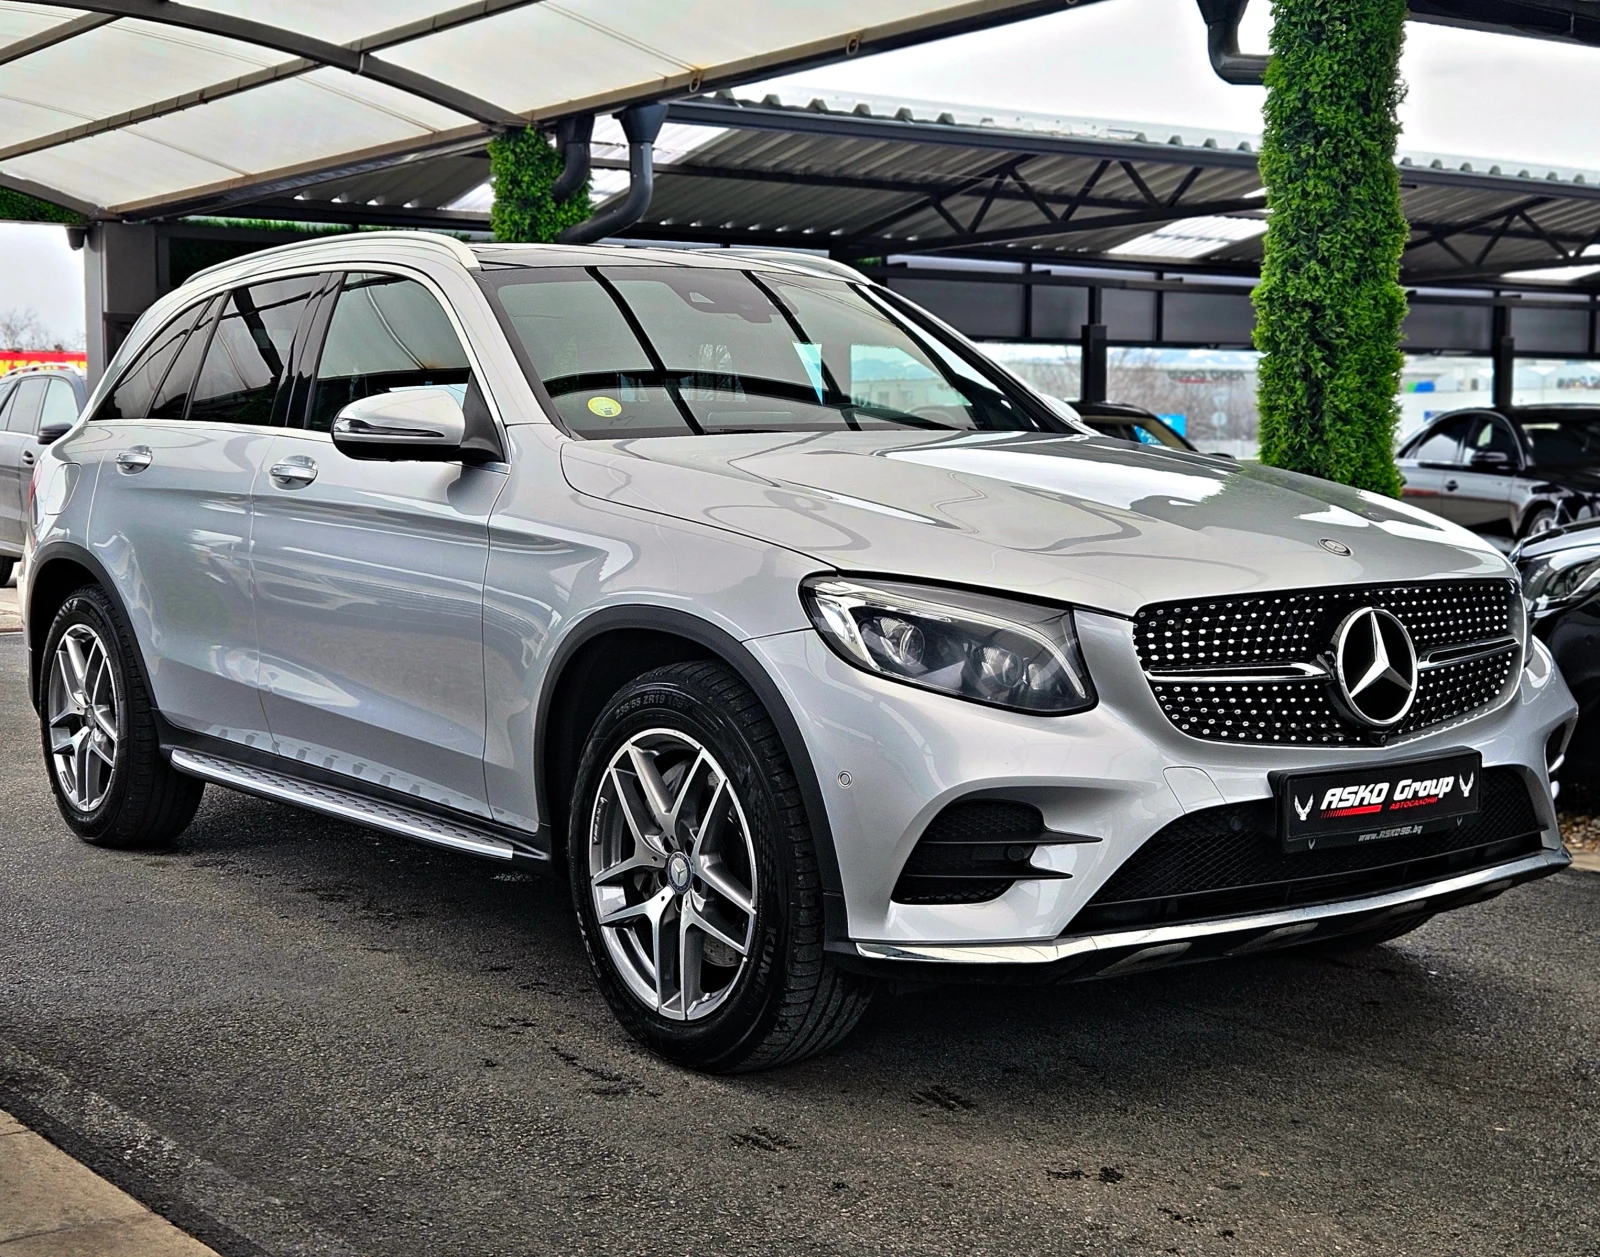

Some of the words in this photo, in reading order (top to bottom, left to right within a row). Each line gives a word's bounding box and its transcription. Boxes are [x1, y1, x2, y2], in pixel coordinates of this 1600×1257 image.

[642, 694, 666, 705] ZR19
[1320, 782, 1390, 810] ASKO
[1393, 776, 1455, 800] Group
